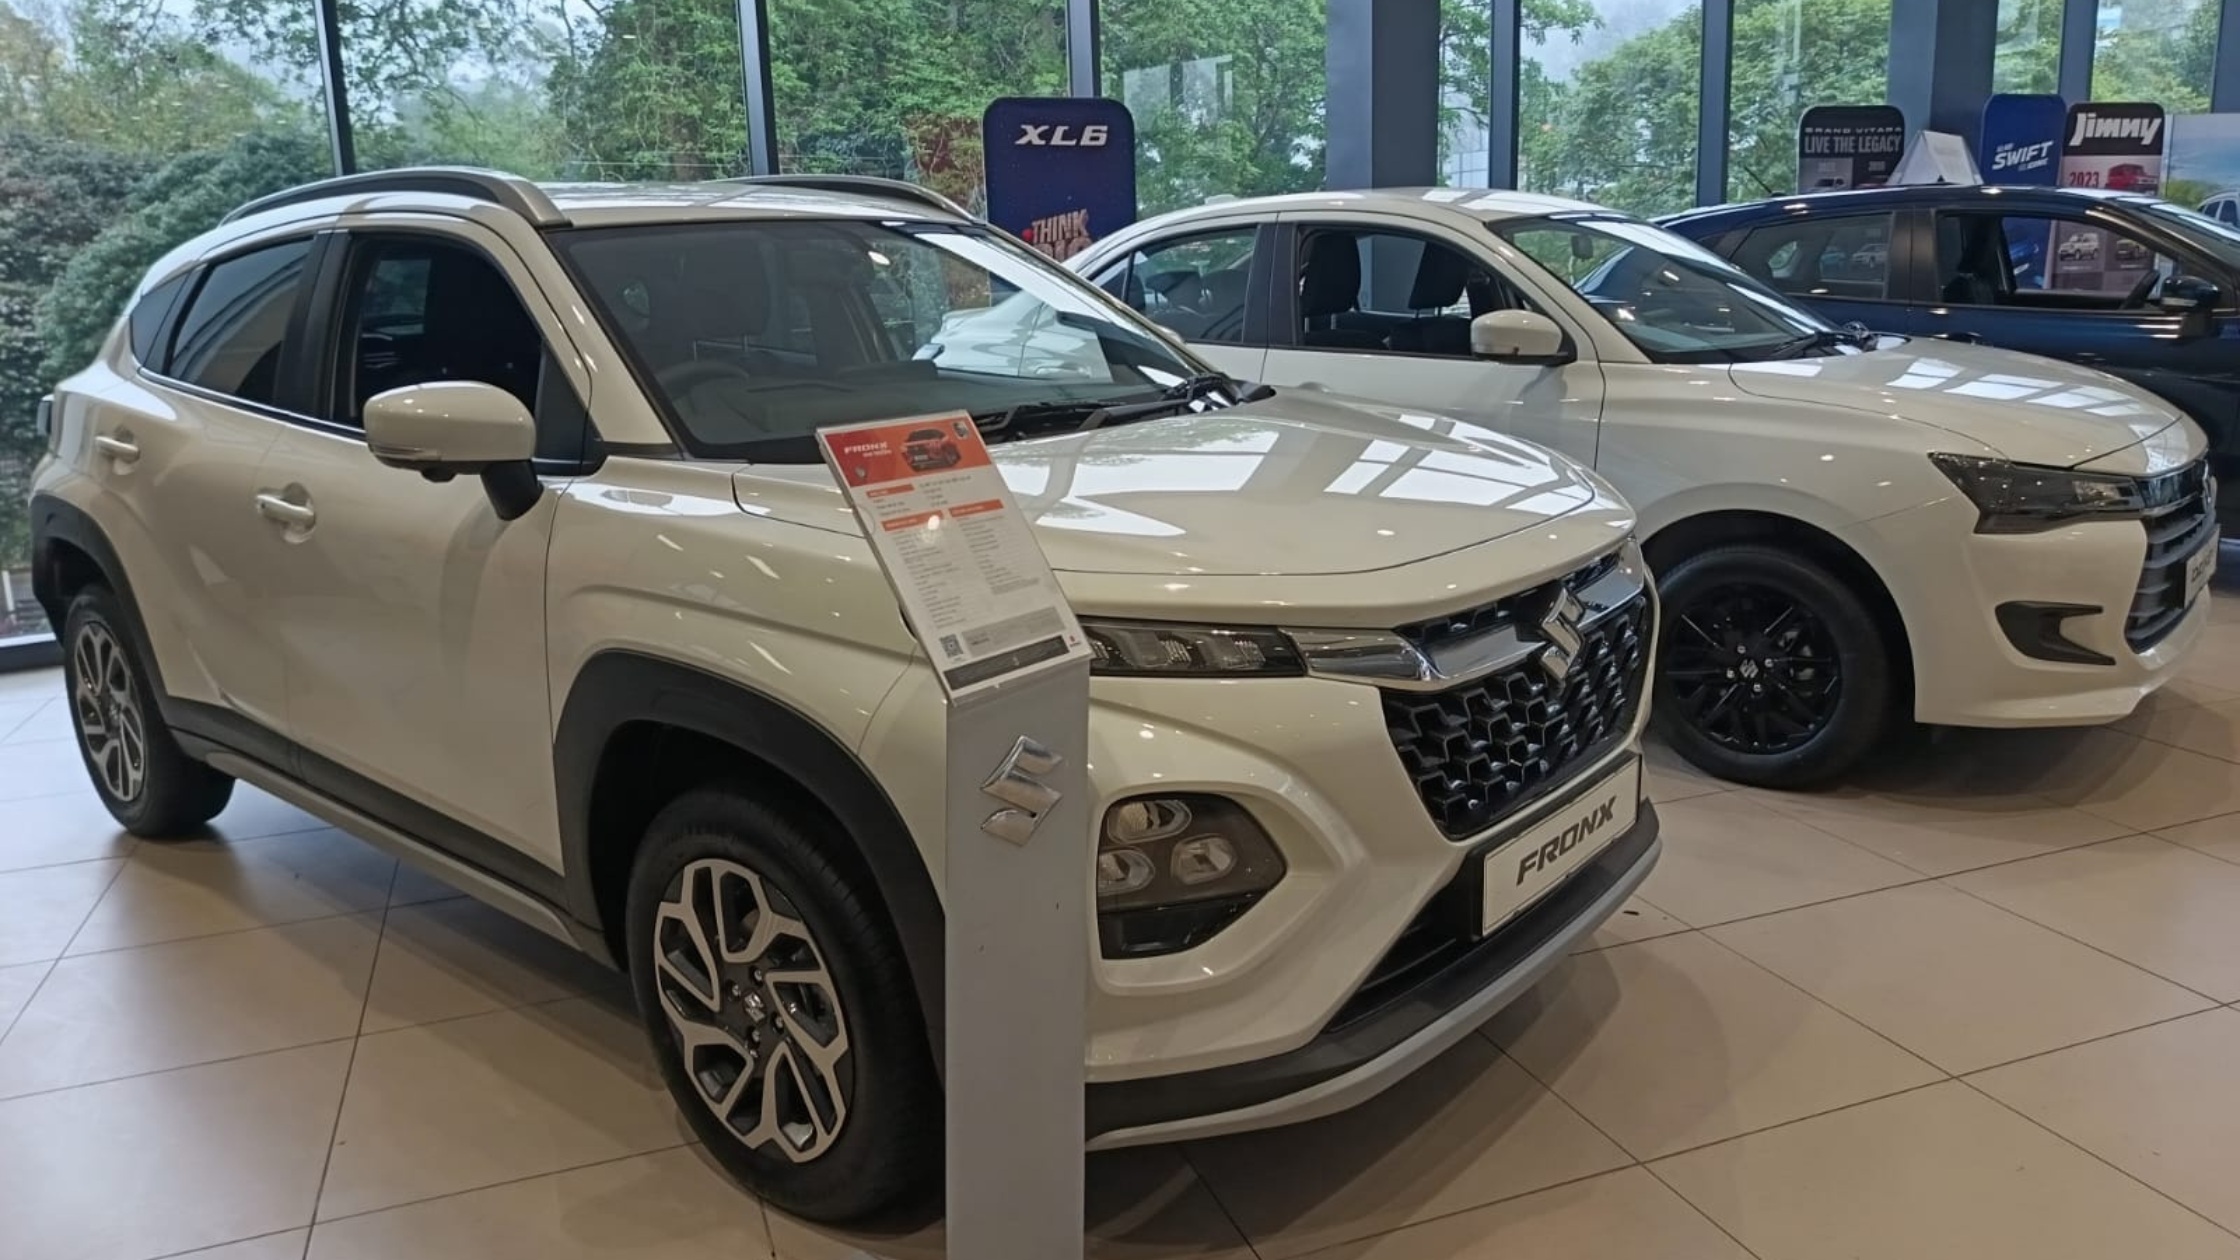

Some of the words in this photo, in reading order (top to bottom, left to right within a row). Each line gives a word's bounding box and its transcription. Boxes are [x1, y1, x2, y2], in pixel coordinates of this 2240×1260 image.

[1015, 125, 1109, 146] XL6
[1804, 135, 1831, 153] LIVE
[1832, 135, 1855, 153] THE
[1858, 134, 1902, 153] LEGACY
[2069, 112, 2162, 146] Jimny
[1992, 140, 2054, 170] SWIFT
[2069, 171, 2100, 188] 2023
[1031, 208, 1090, 244] THINK
[1515, 795, 1617, 887] FRONX
